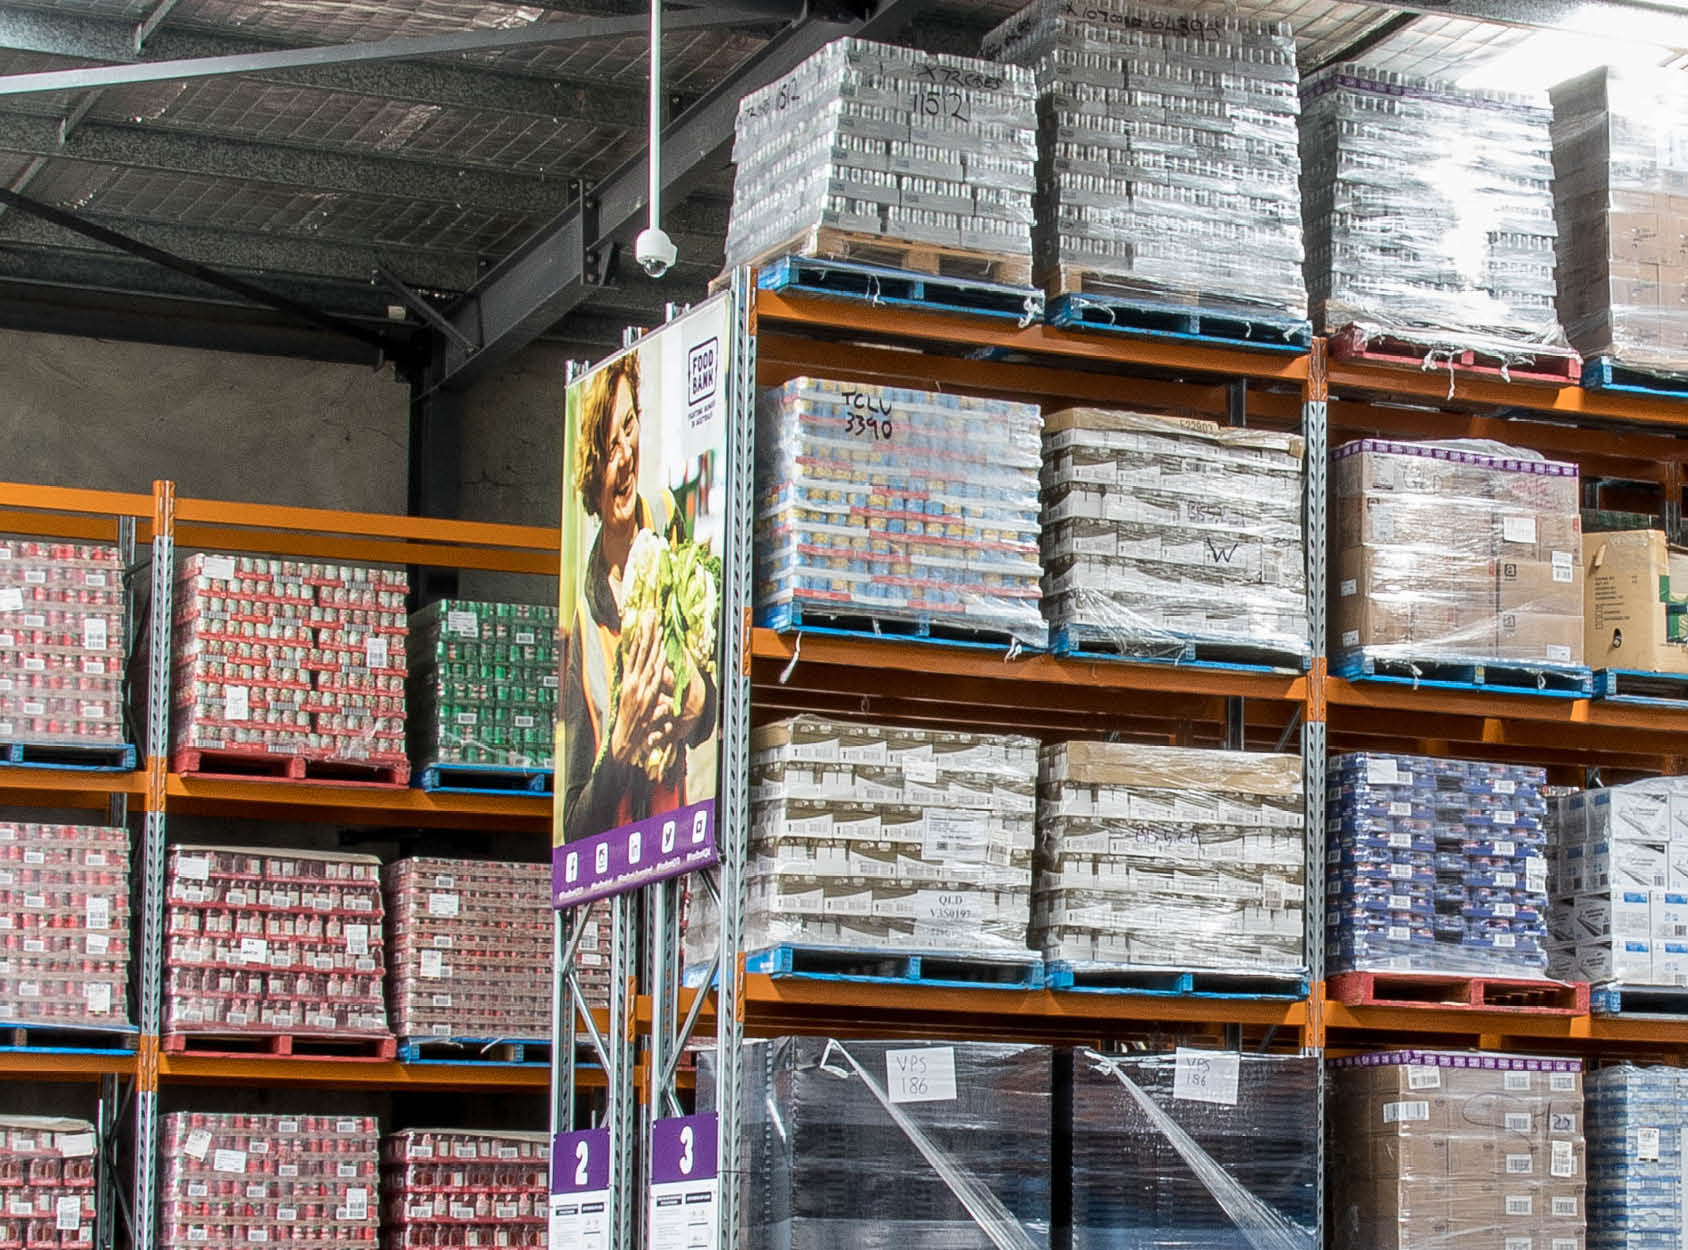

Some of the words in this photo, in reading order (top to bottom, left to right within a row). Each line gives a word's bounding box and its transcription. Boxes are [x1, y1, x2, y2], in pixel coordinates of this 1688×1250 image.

[692, 349, 714, 376] FOOD
[692, 368, 714, 394] BANK
[845, 412, 893, 440] 3390
[1207, 537, 1238, 563] W
[938, 895, 963, 906] QLD
[896, 1055, 927, 1073] VPS
[902, 1077, 928, 1095] 186
[1186, 1072, 1207, 1087] 186
[575, 1141, 589, 1185] 2
[679, 1125, 694, 1175] 3
